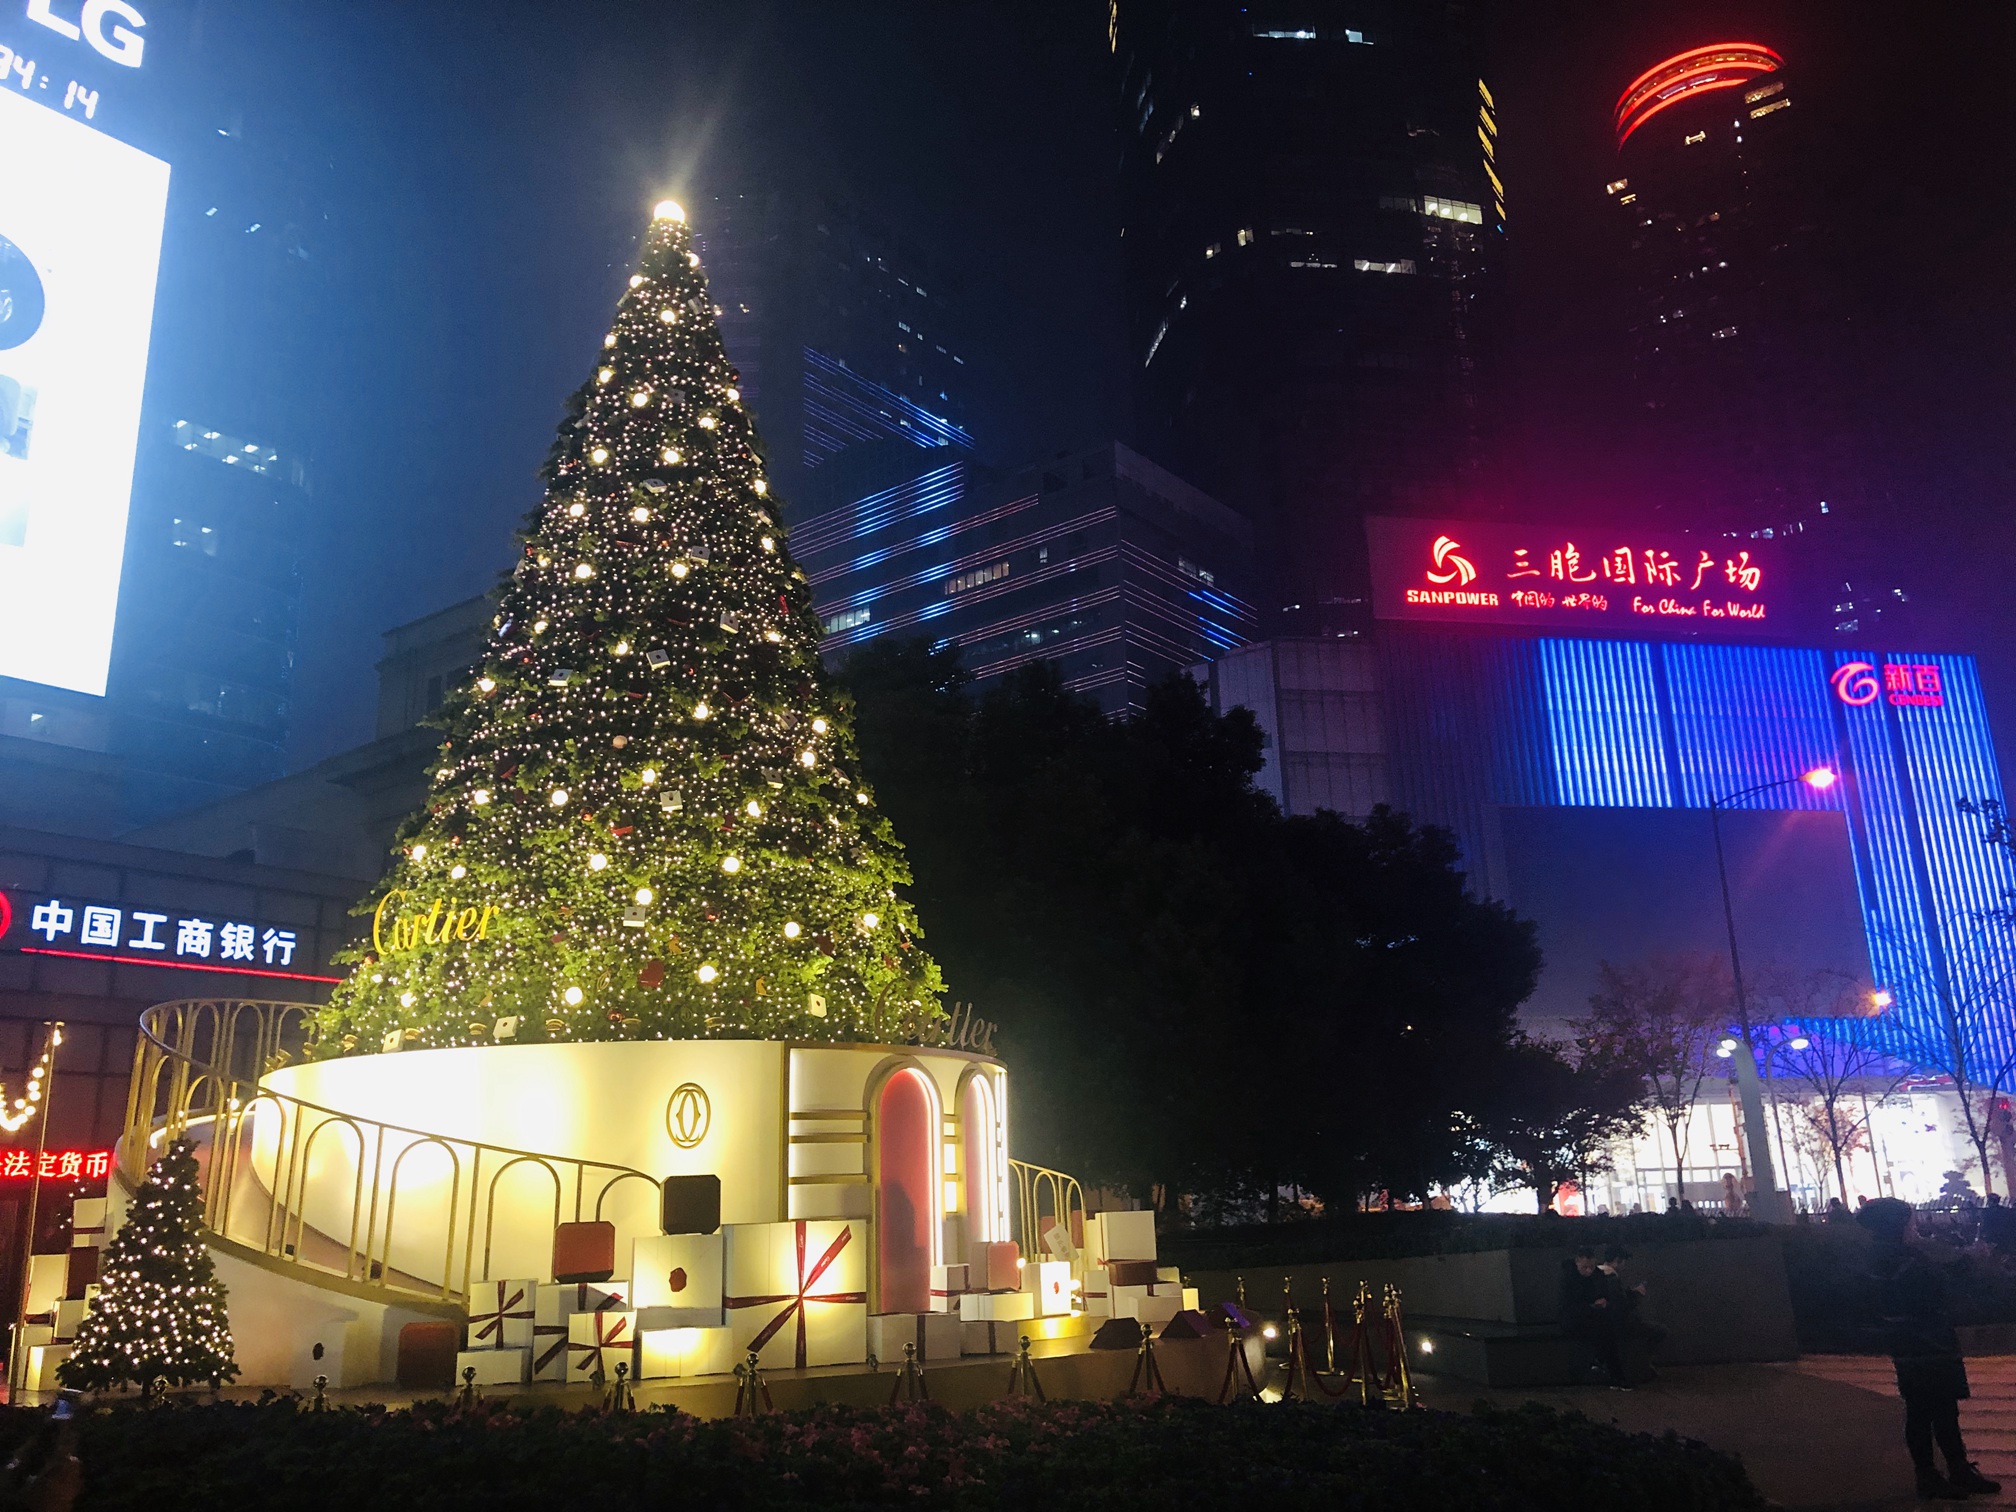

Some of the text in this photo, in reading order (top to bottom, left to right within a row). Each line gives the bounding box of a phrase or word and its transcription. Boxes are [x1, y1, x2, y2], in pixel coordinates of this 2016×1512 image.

[27, 0, 146, 68] LG
[1507, 542, 1761, 591] 三胞国际广场
[1407, 589, 1499, 607] SANPOWER
[1511, 590, 1555, 608] 中国的
[1633, 596, 1766, 618] For China For World
[1883, 662, 1941, 692] 新百
[31, 899, 297, 966] 中国工商银行
[373, 888, 500, 955] Cartier
[0, 1150, 108, 1178] 法定货币
